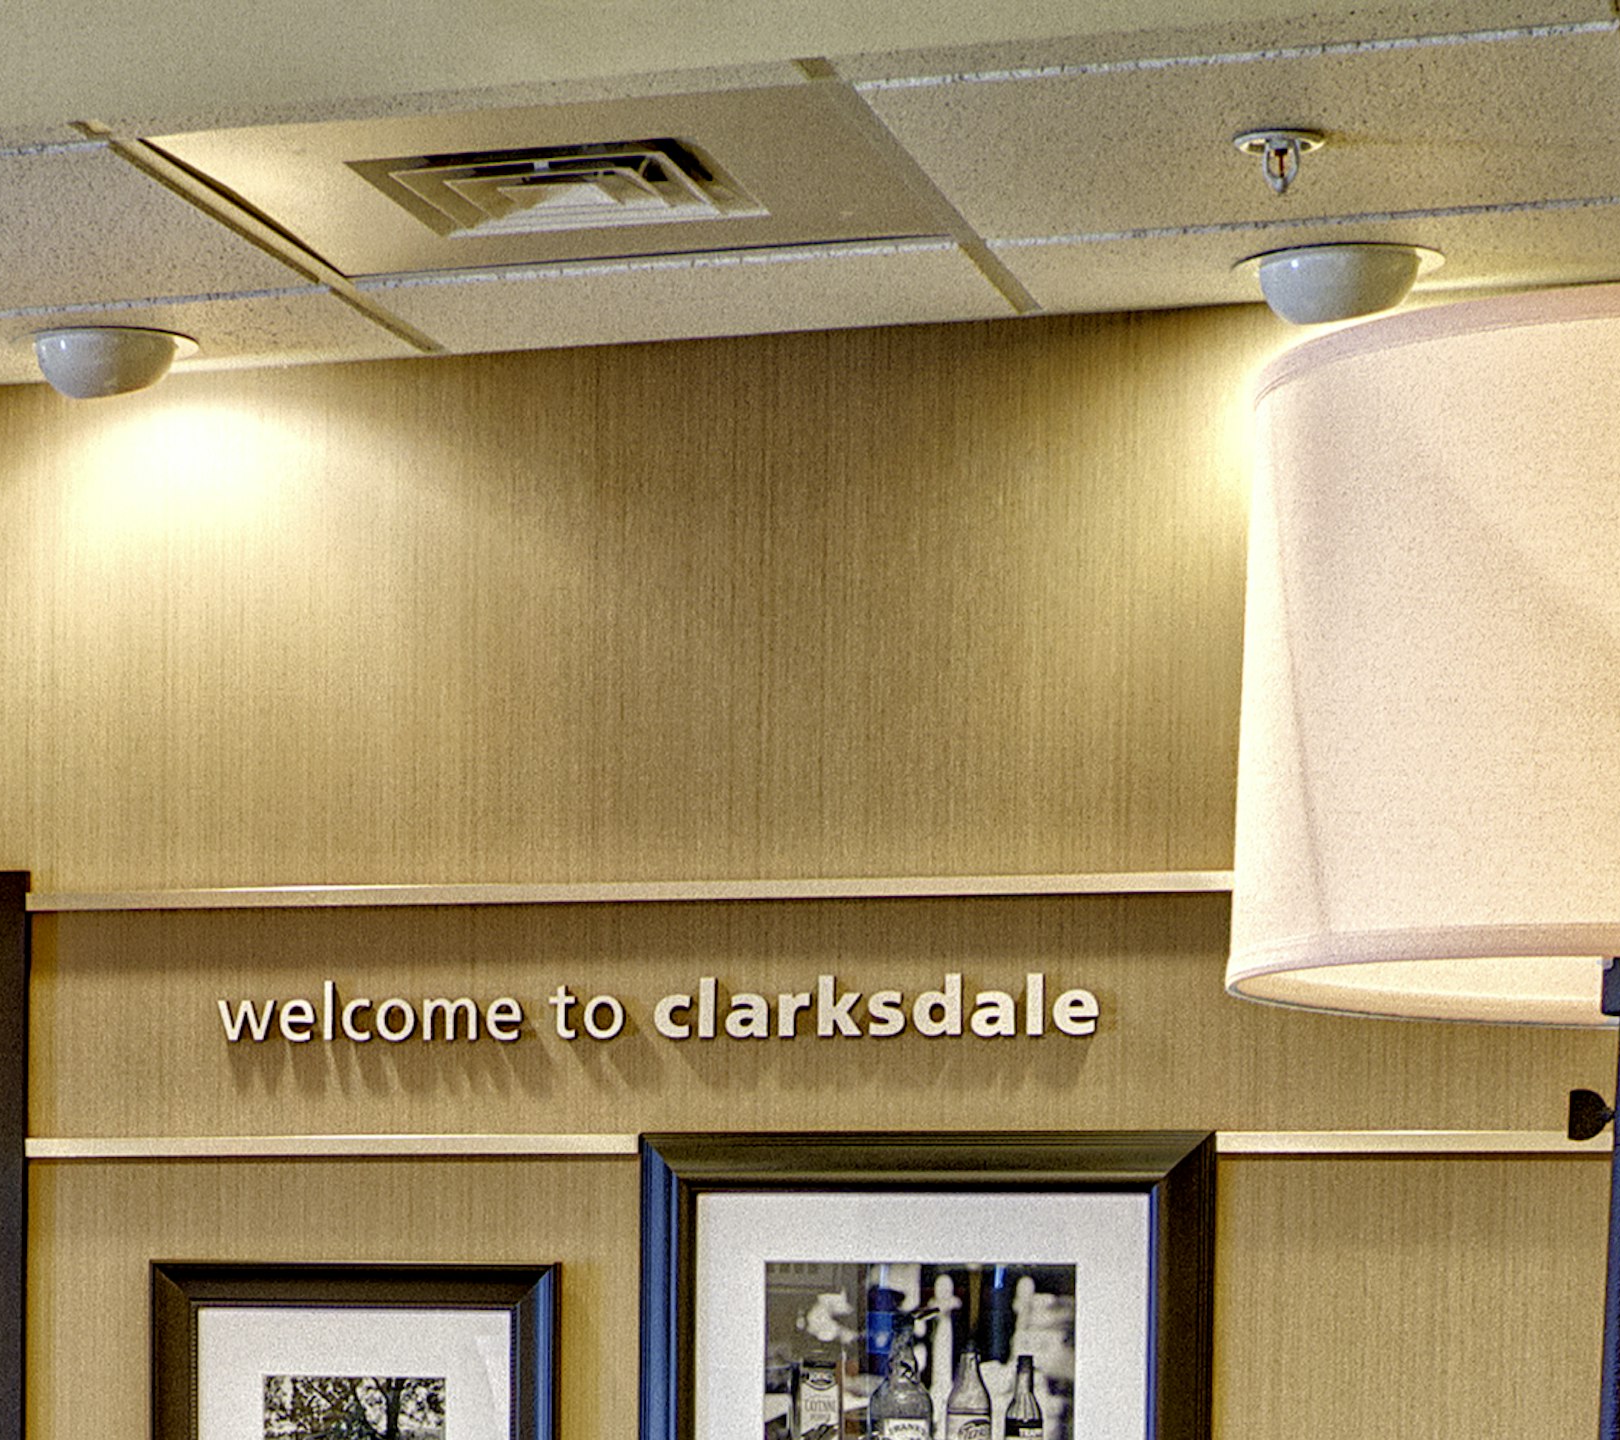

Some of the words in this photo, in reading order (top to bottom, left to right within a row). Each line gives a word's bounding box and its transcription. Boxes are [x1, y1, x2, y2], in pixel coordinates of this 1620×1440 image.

[218, 980, 523, 1042] welcome
[549, 984, 626, 1040] to
[653, 973, 1101, 1040] clarksdale
